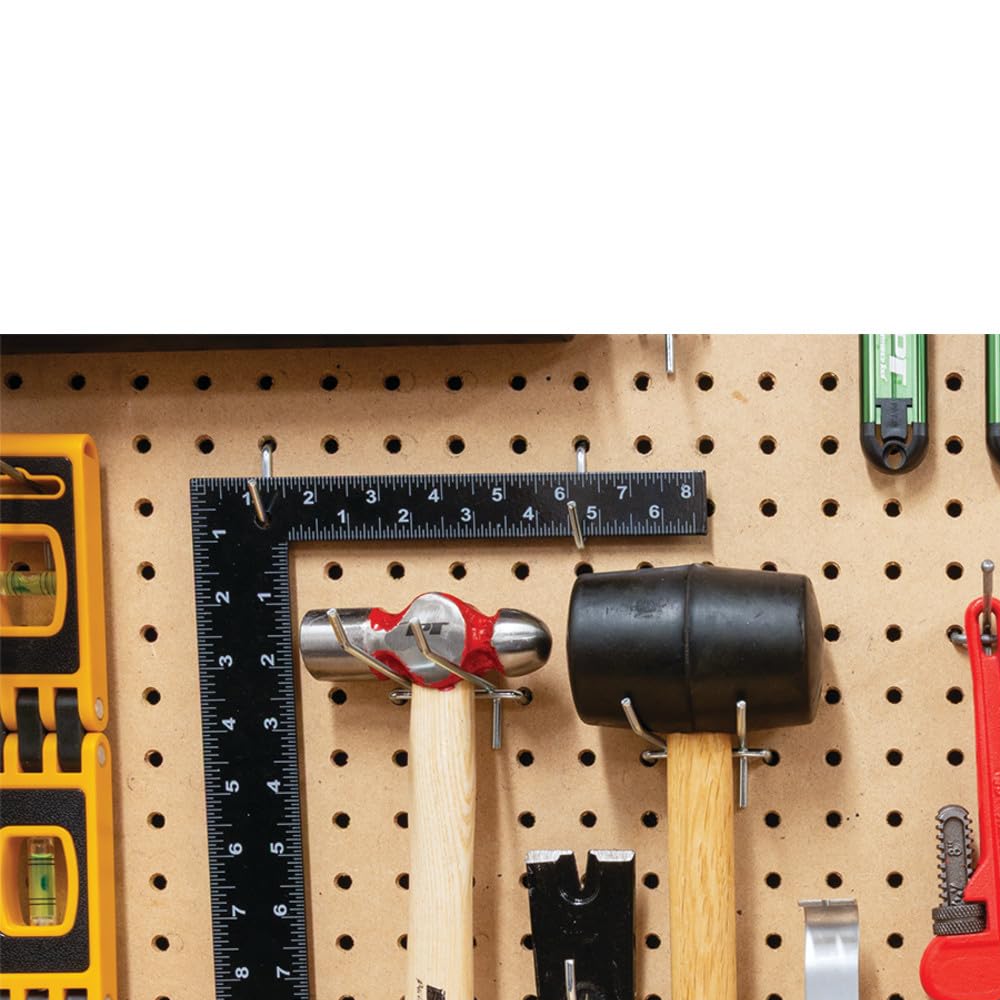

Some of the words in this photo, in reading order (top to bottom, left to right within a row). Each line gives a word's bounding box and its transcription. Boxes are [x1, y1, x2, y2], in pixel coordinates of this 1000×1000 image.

[242, 493, 250, 505] 1
[303, 491, 314, 504] 2
[366, 490, 377, 504] 3
[428, 489, 439, 502] 4
[492, 488, 502, 501] 5
[555, 487, 565, 500] 6
[617, 486, 627, 499] 7
[681, 484, 691, 498] 8
[337, 510, 345, 523] 1
[398, 509, 409, 523] 2
[461, 508, 471, 522] 3
[523, 507, 534, 520] 4
[587, 506, 597, 519] 5
[649, 505, 660, 518] 6
[212, 530, 226, 538] 1
[216, 592, 229, 603] 2
[257, 593, 271, 601] 1
[219, 655, 232, 667] 3
[261, 654, 274, 666] 2
[222, 717, 235, 730] 4
[264, 718, 278, 729] 3
[225, 780, 239, 792] 5
[267, 780, 280, 792] 4
[229, 843, 242, 854] 6
[270, 843, 284, 854] 5
[232, 905, 246, 916] 7
[273, 905, 287, 916] 6
[235, 967, 249, 978] 8
[277, 967, 290, 978] 7
